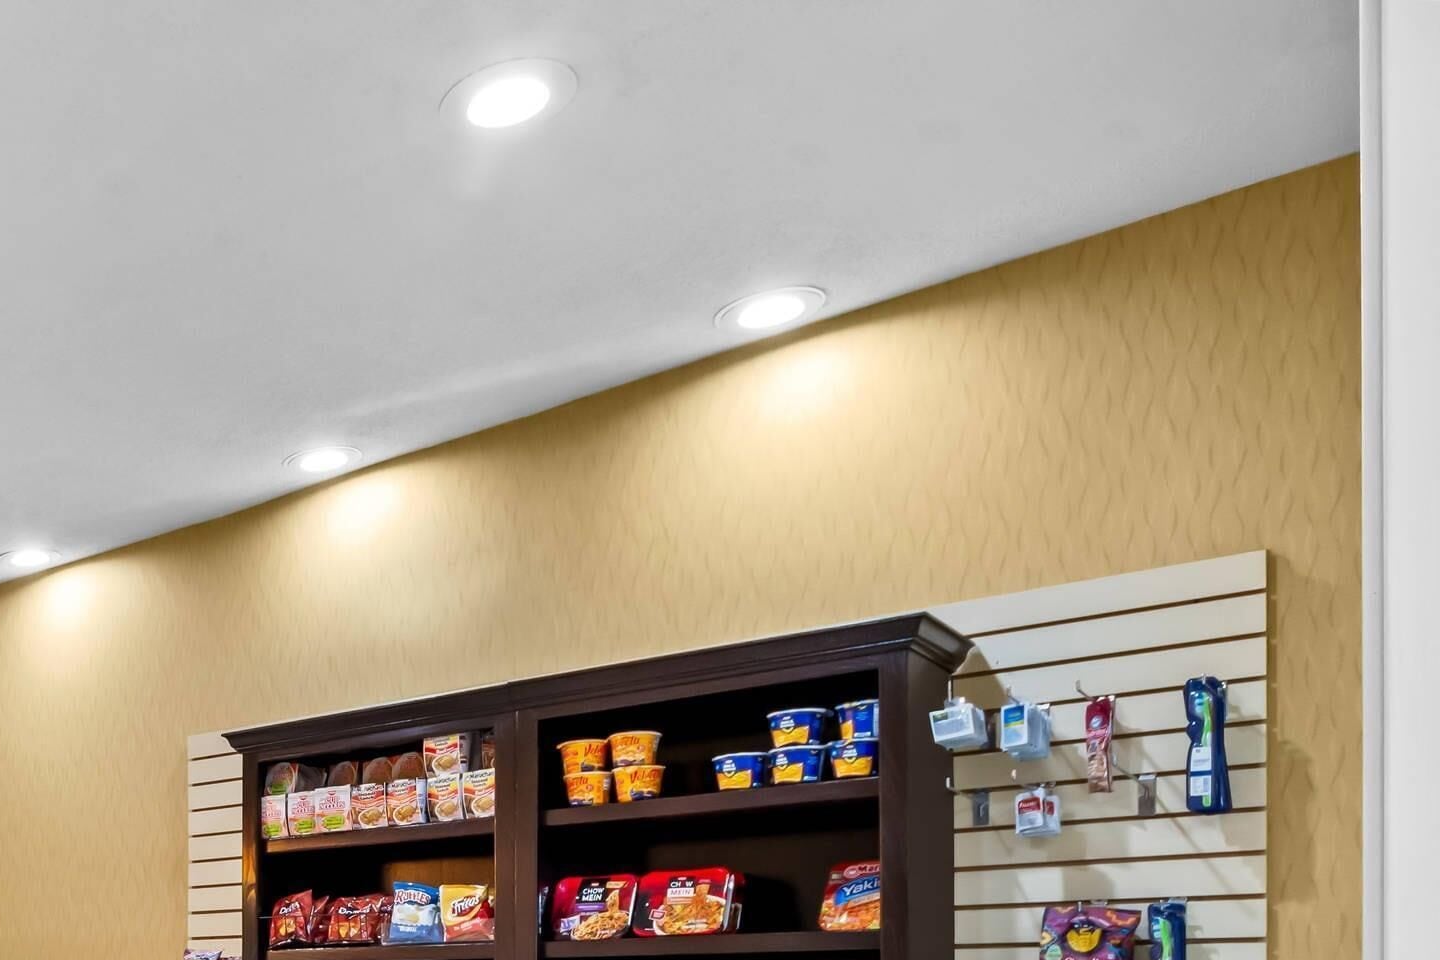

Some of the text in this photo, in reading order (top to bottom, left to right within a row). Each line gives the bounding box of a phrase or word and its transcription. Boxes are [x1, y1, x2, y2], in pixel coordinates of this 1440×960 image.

[842, 877, 880, 896] Yaki
[582, 887, 605, 895] CHOW
[581, 894, 603, 902] MEIN
